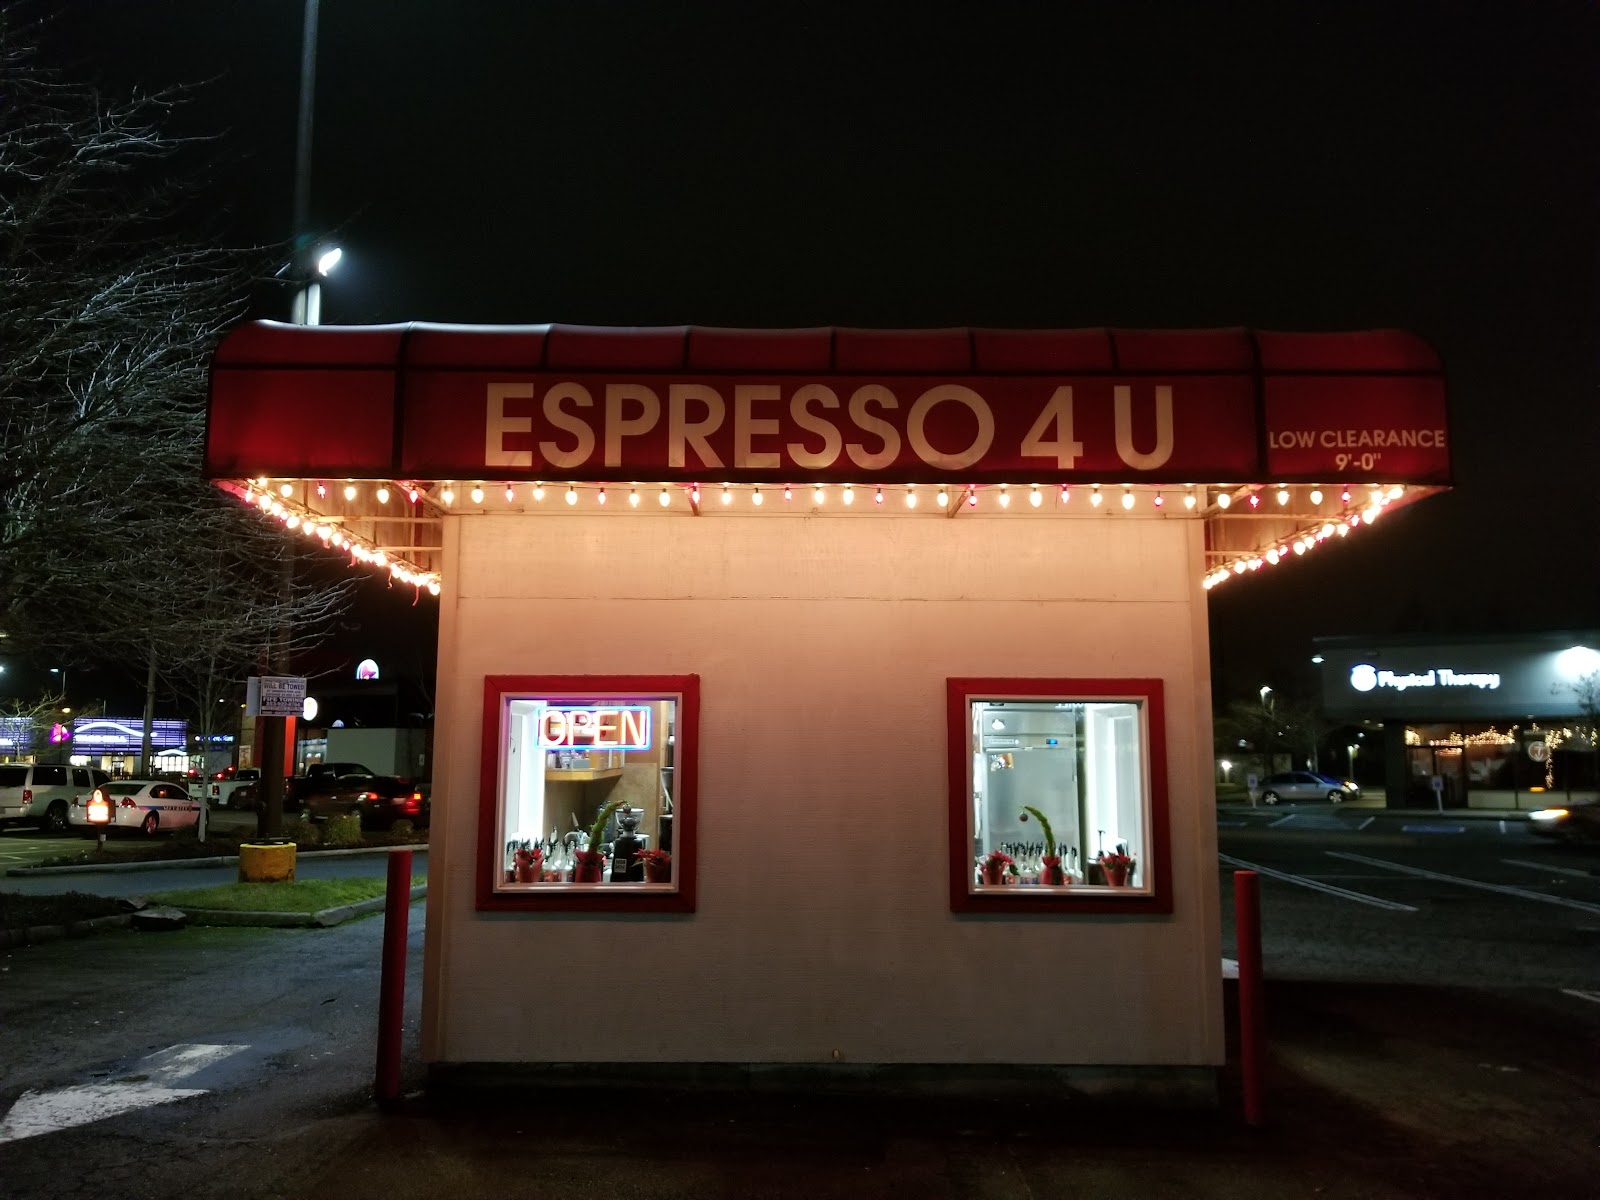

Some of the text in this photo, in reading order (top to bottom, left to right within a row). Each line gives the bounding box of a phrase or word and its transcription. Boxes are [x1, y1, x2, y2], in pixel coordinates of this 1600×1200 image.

[485, 382, 1174, 471] ESPRESSO 4 U
[1269, 430, 1445, 448] LOW CLEARANCE
[1377, 669, 1500, 691] Physical Therapy
[539, 710, 647, 747] OPEN
